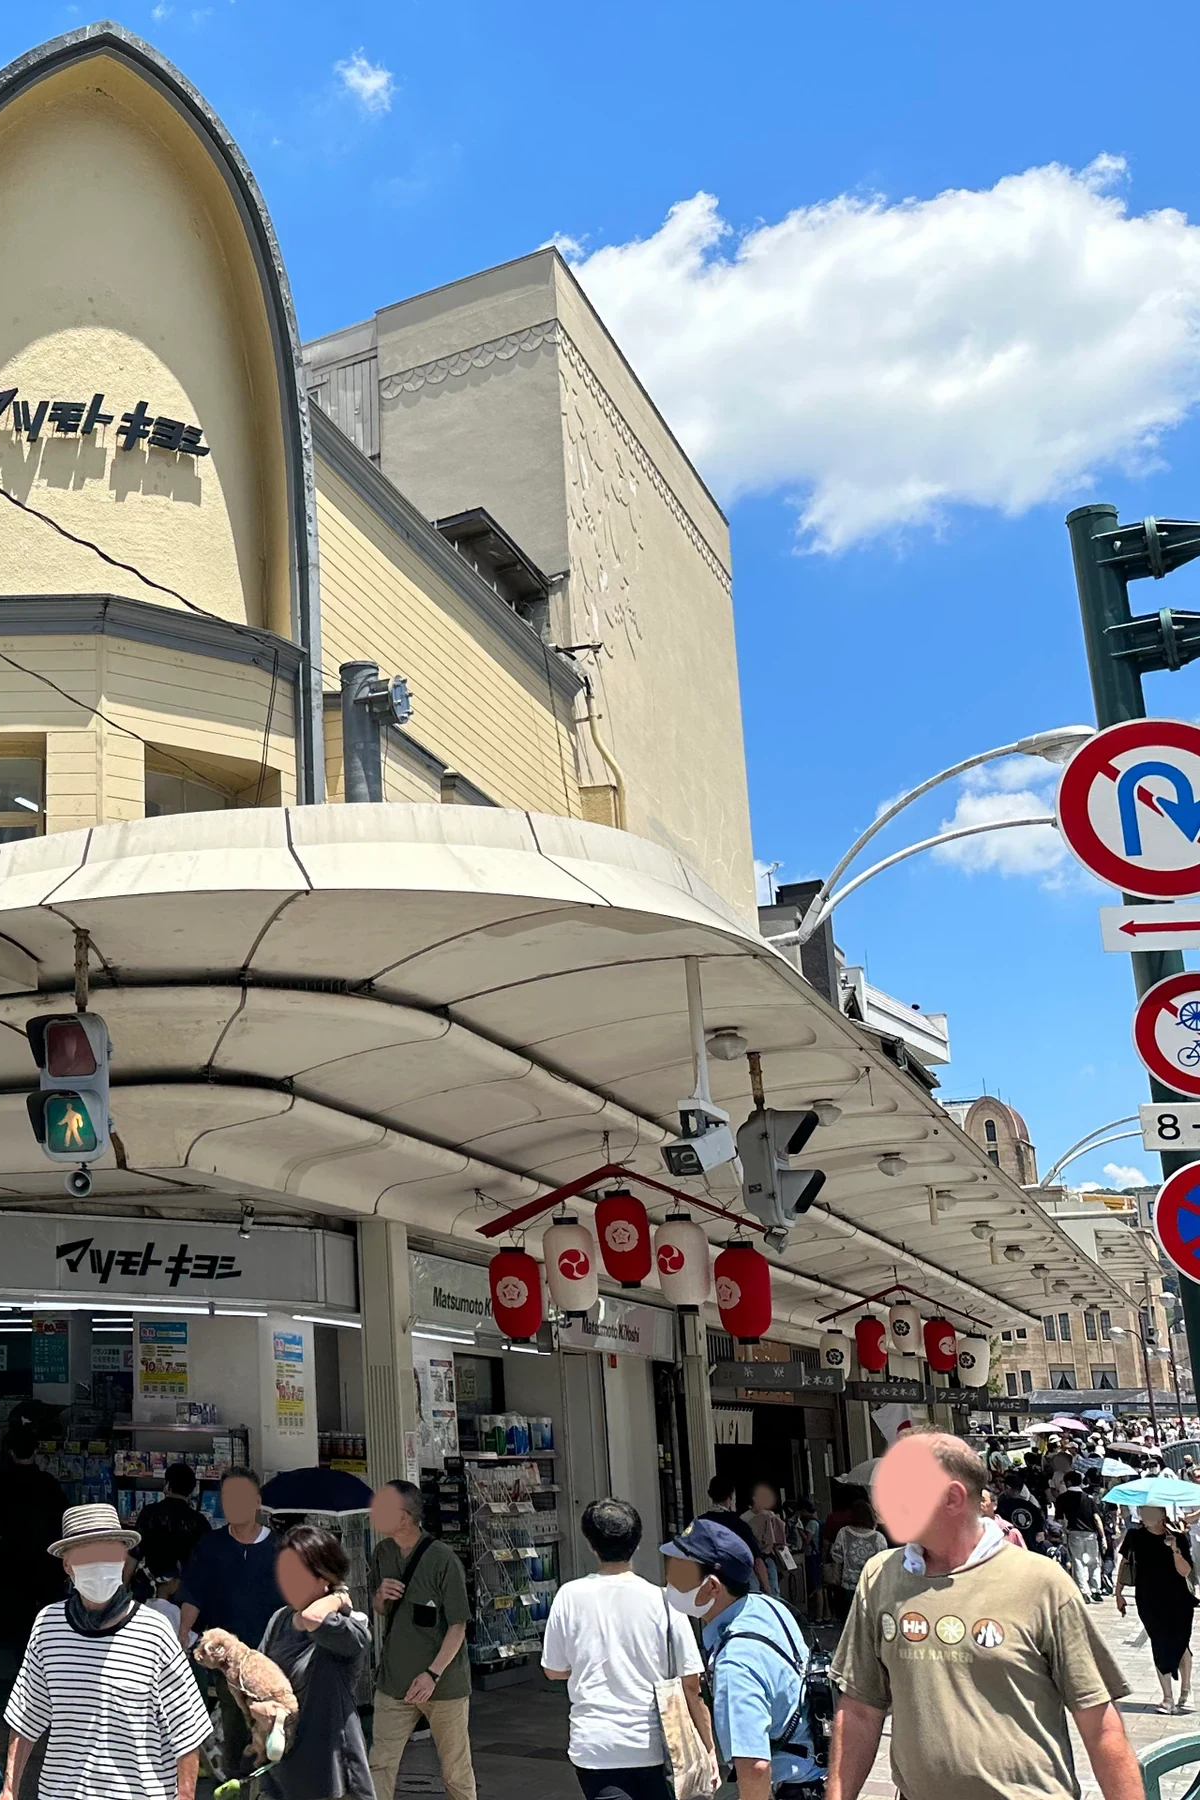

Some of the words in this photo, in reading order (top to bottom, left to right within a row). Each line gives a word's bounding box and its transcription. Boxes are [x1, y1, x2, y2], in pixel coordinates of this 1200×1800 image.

[56, 1237, 242, 1287] マツモトキヨシ
[432, 1286, 484, 1315] Matsumoto
[938, 1391, 980, 1401] タニグチ
[902, 1619, 927, 1634] HH
